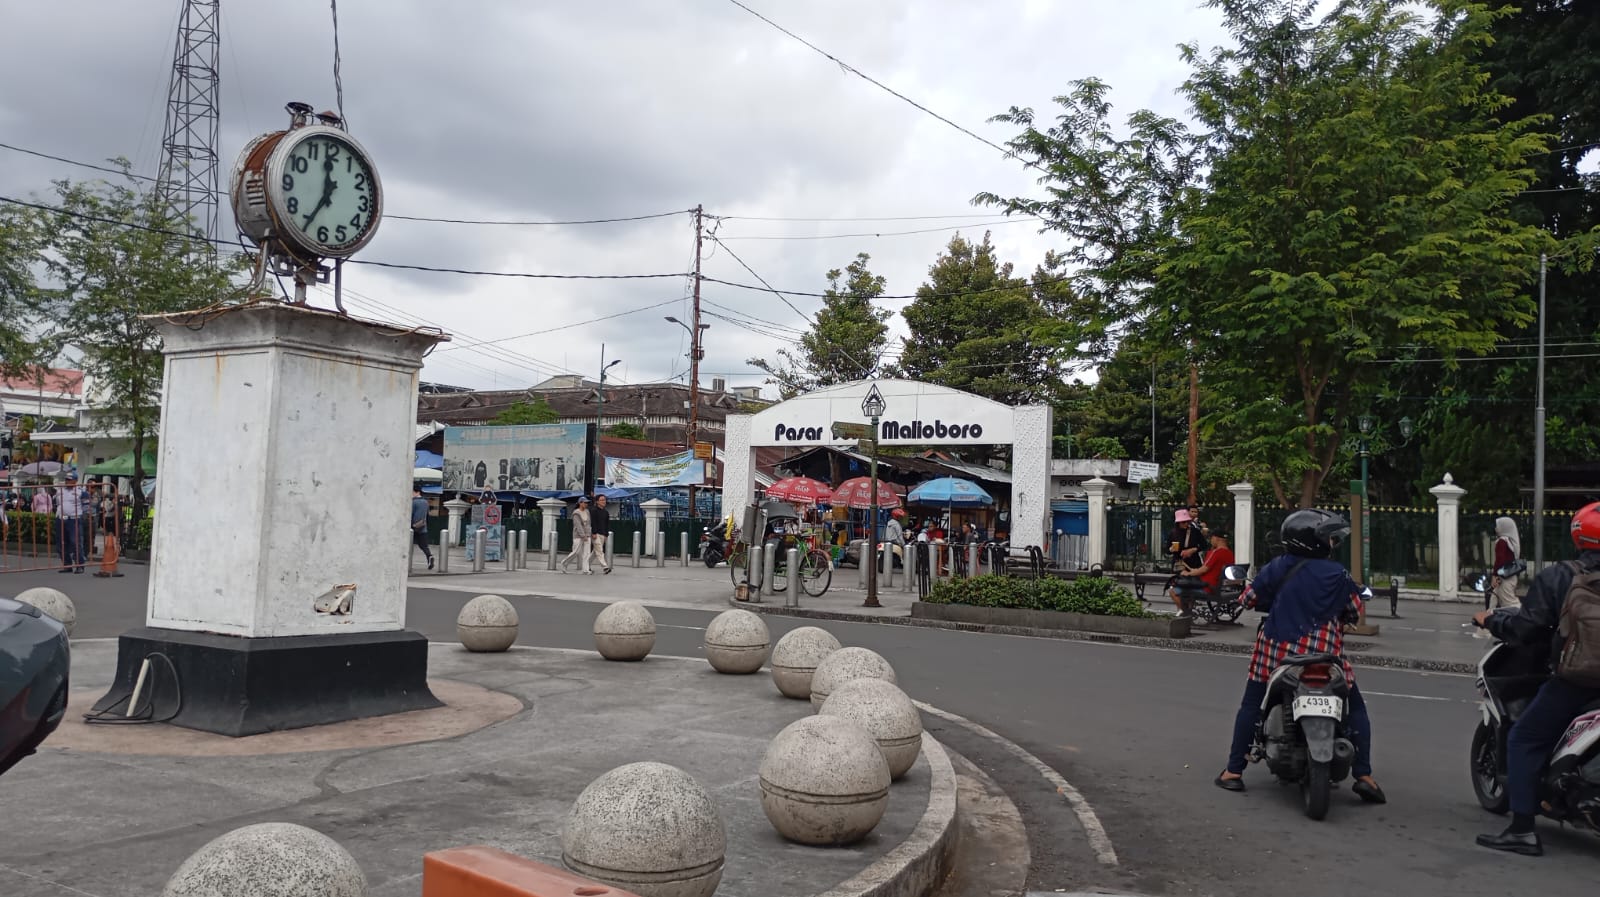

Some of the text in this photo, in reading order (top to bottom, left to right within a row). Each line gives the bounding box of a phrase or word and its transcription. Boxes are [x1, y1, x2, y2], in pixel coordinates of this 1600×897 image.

[307, 141, 318, 160] 11
[323, 142, 340, 162] 12
[289, 154, 308, 174] 10
[346, 156, 353, 173] 1
[282, 174, 294, 192] 9
[354, 173, 365, 191] 2
[287, 196, 298, 214] 8
[357, 195, 369, 213] 3
[349, 213, 361, 230] 4
[317, 226, 329, 243] 6
[335, 225, 347, 242] 5
[774, 423, 823, 441] Pasar
[881, 420, 983, 439] Malioboro
